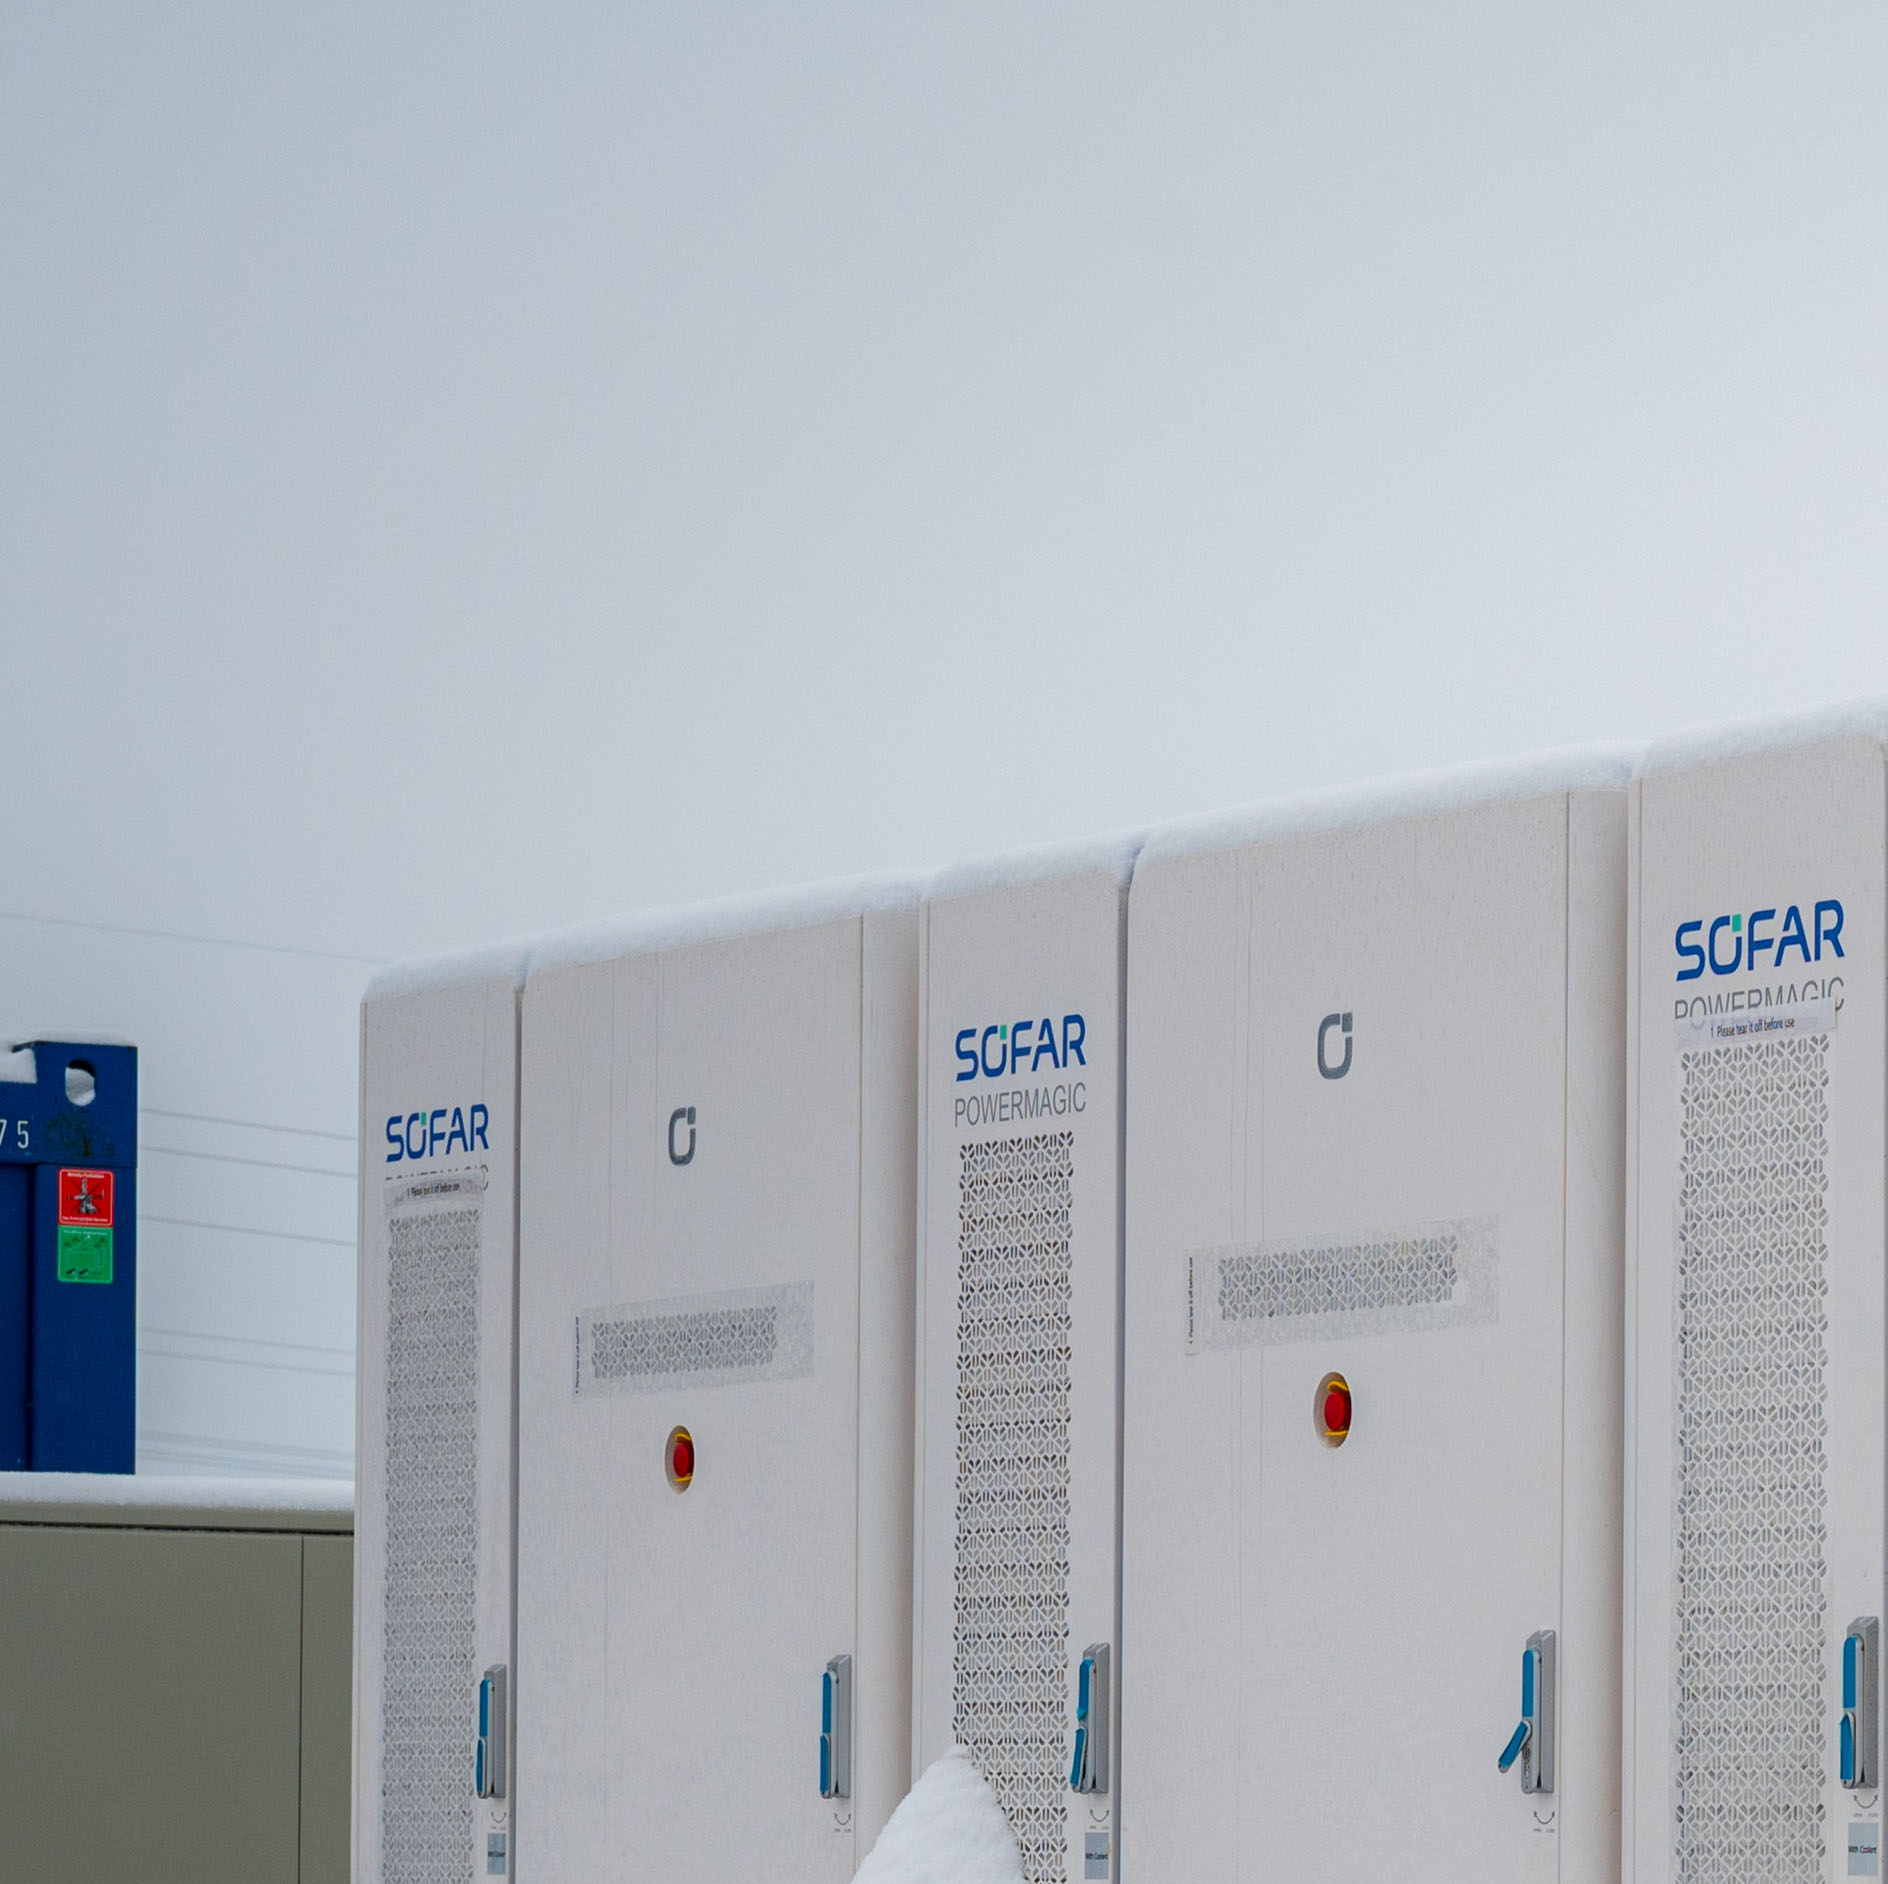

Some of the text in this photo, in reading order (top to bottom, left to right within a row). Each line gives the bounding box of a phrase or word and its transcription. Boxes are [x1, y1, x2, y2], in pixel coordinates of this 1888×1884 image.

[1675, 899, 1845, 982] SOFAR
[955, 1014, 1087, 1082] SOFAR
[385, 1103, 489, 1163] SOFAR
[955, 1082, 1087, 1128] POWERMAGIC
